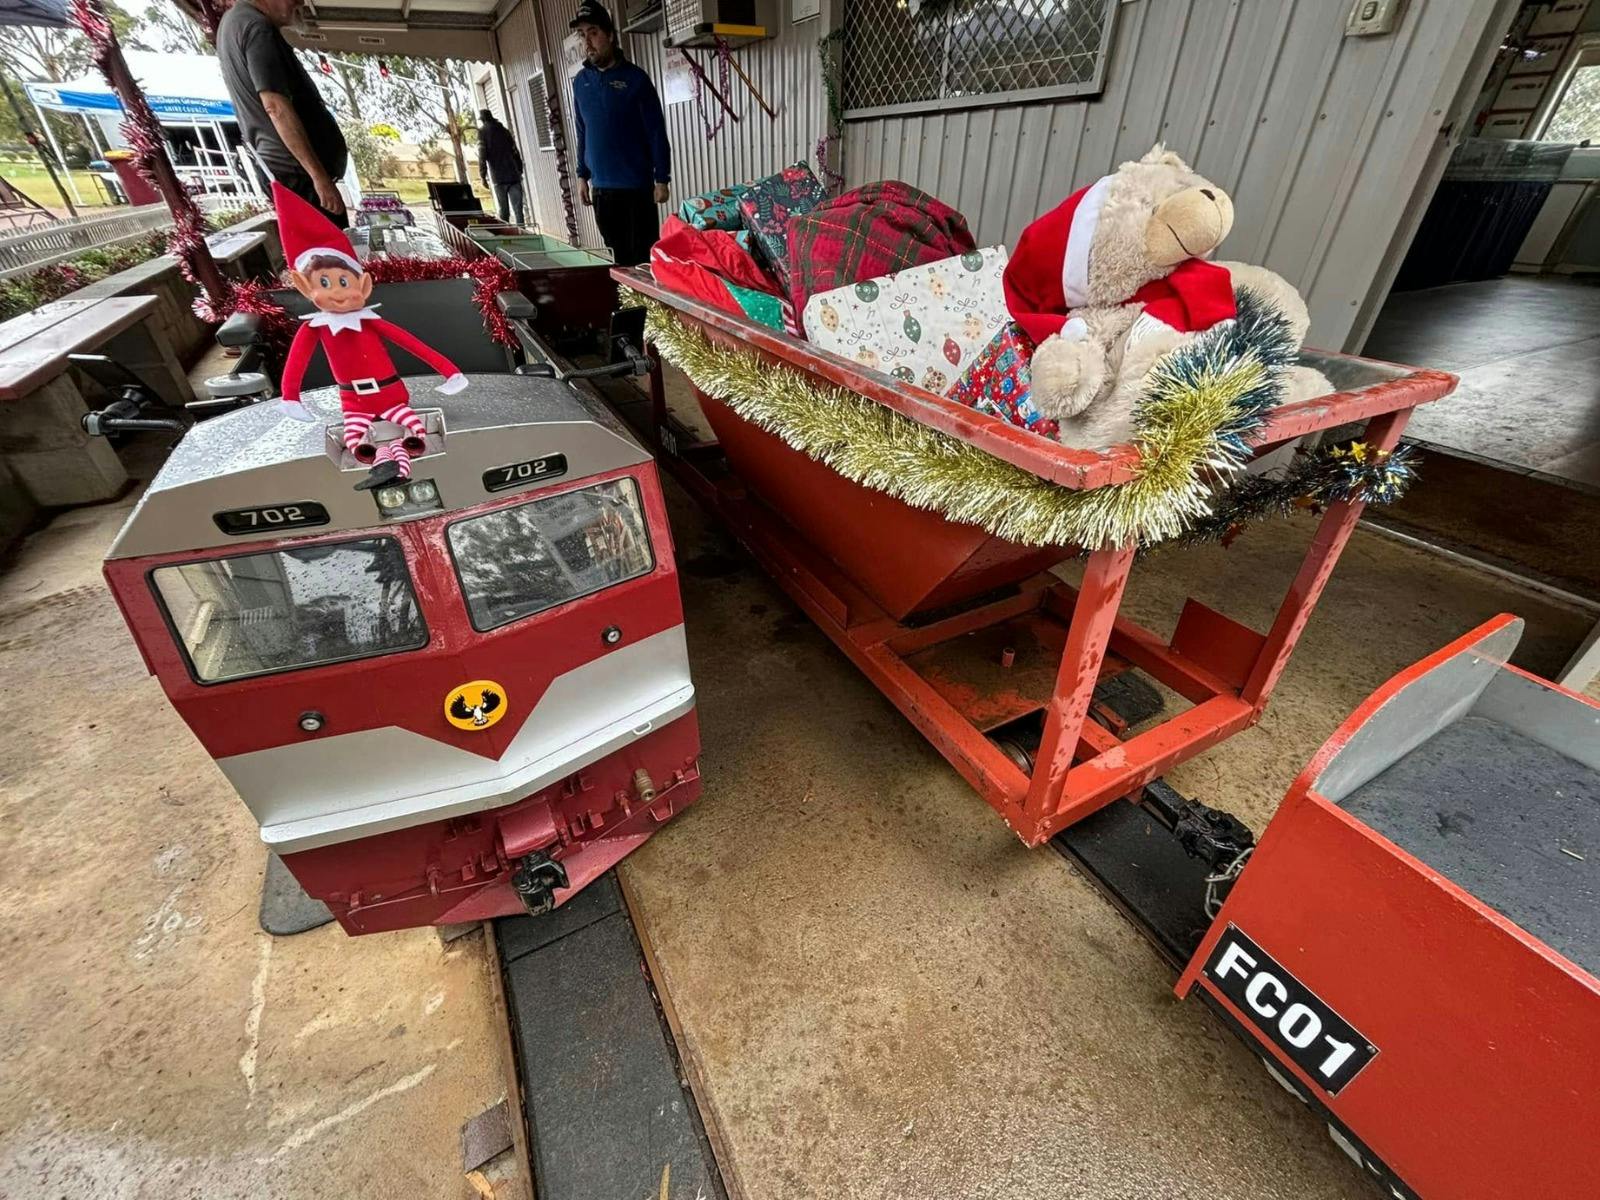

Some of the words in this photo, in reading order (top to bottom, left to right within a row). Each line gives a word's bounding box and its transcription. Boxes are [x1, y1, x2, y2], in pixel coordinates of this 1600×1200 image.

[501, 460, 547, 481] 702
[240, 506, 305, 526] 702
[1215, 941, 1356, 1078] FC01
